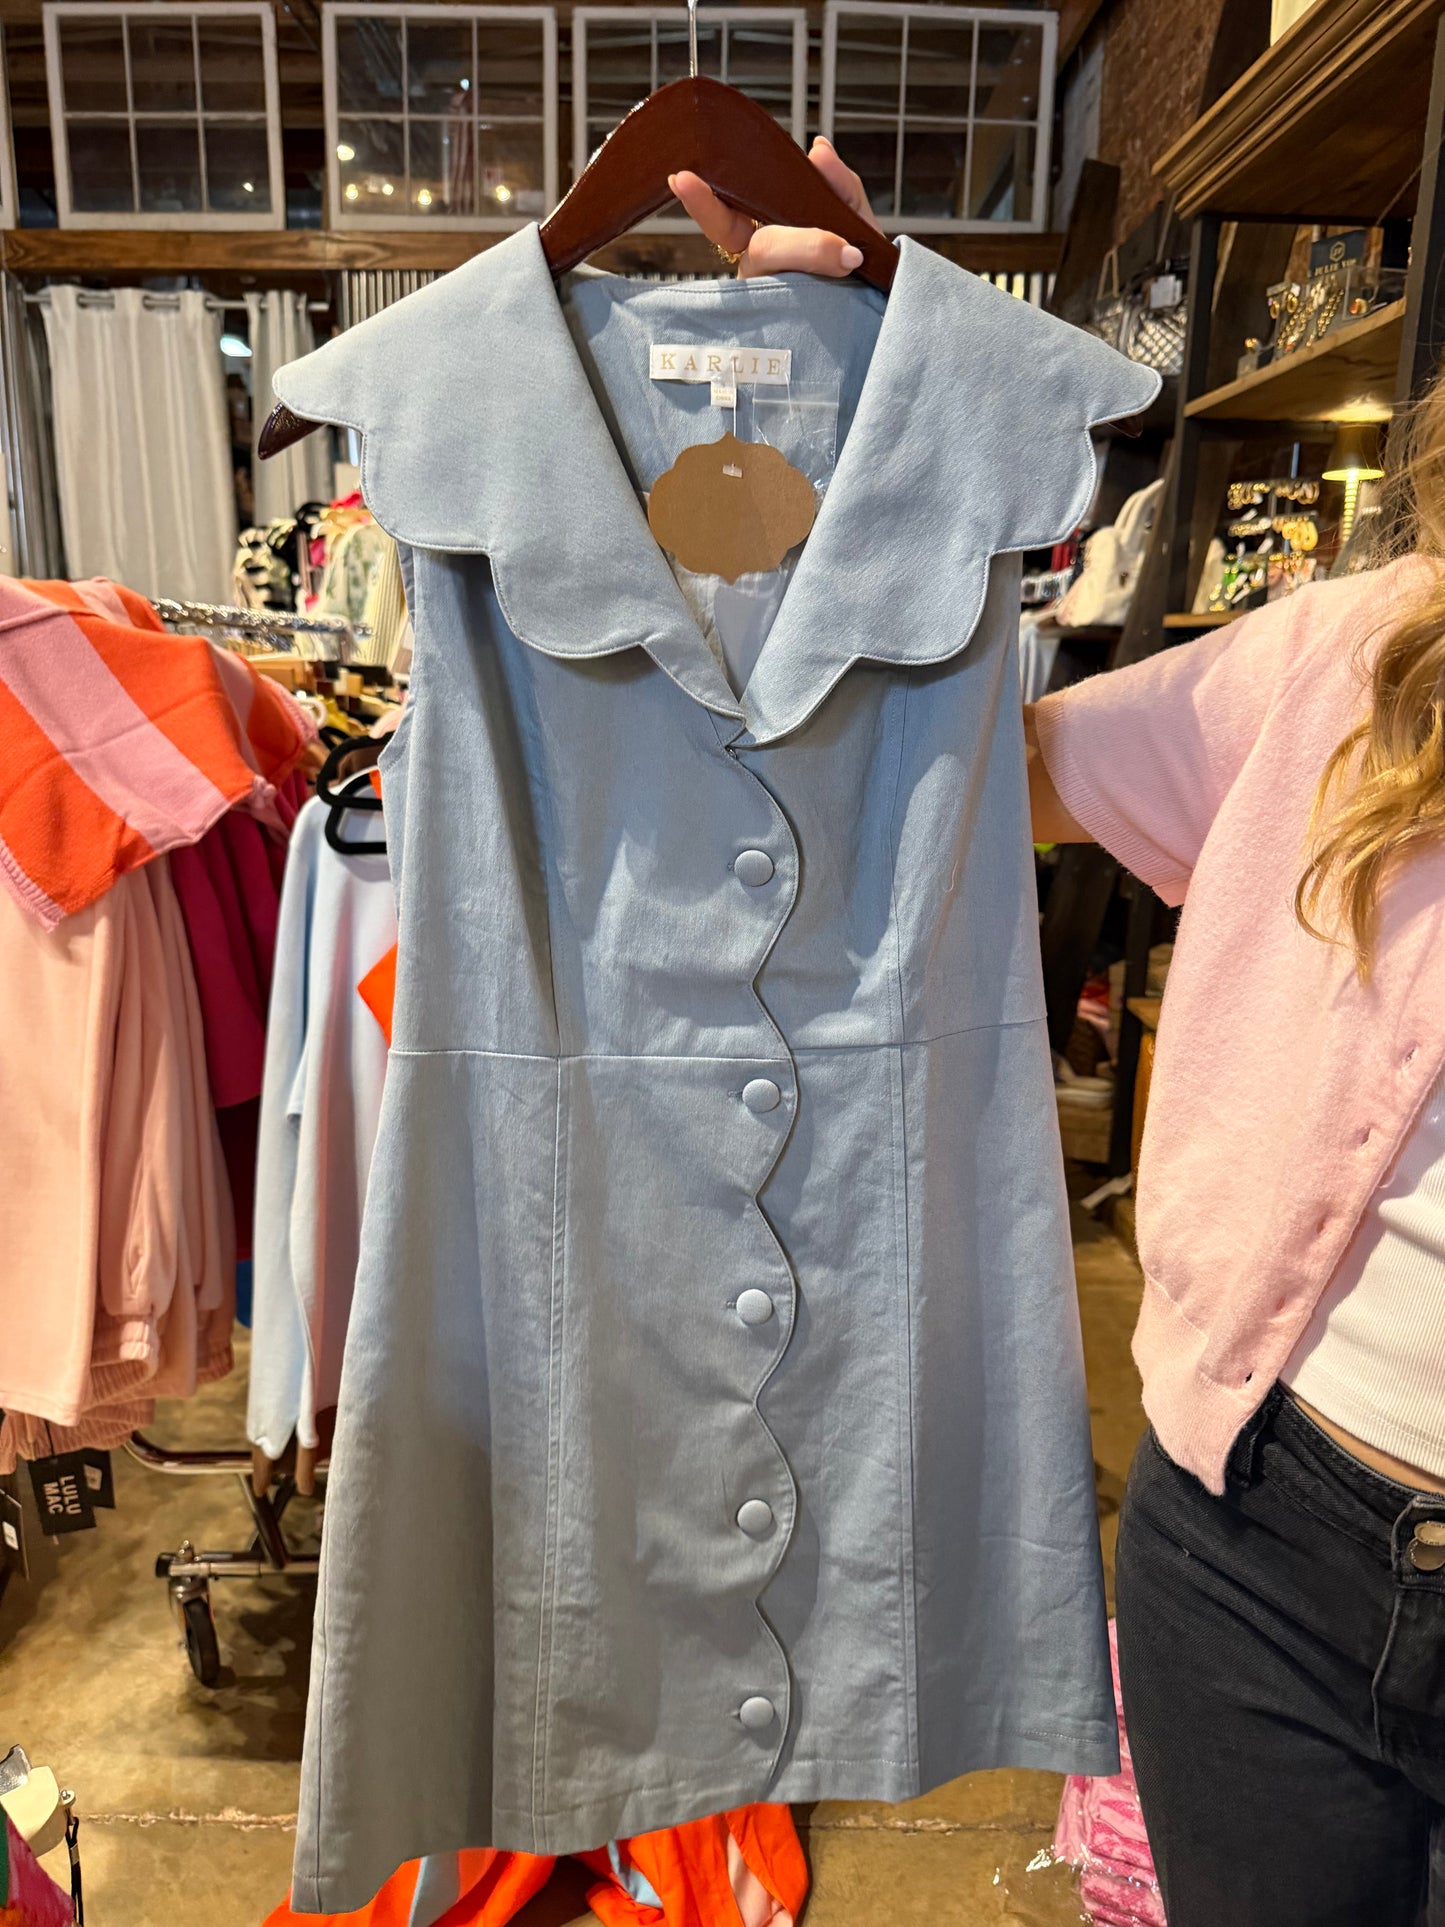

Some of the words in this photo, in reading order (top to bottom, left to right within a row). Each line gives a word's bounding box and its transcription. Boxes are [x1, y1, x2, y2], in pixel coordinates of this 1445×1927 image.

[660, 353, 781, 375] KARLIE
[43, 1481, 64, 1515] MAC
[60, 1475, 82, 1515] LULU
